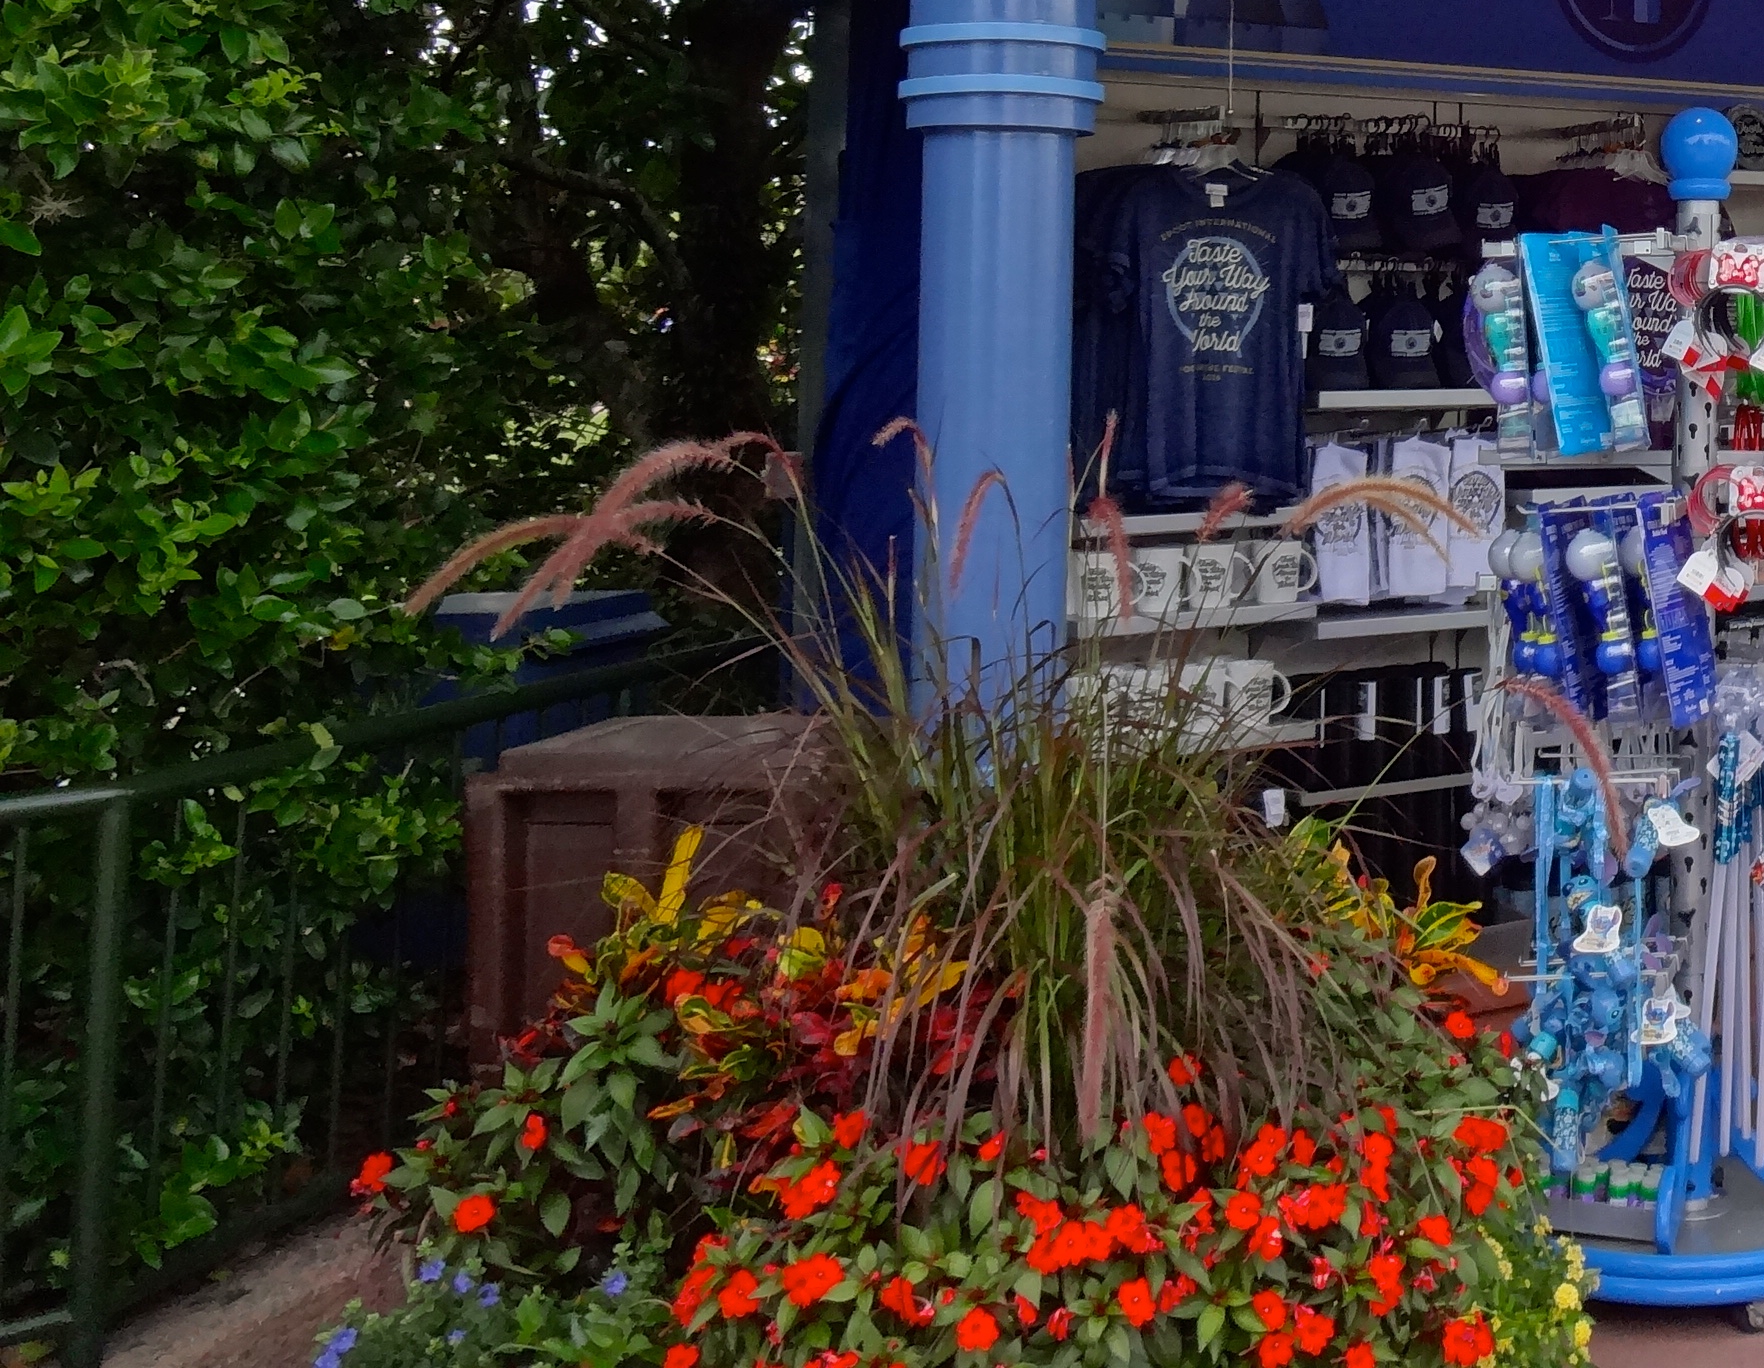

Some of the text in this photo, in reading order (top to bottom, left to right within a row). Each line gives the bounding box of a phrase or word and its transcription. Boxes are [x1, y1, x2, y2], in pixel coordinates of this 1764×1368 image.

[1195, 218, 1277, 244] INTERNATIONAL
[1187, 238, 1243, 264] Taste
[1161, 263, 1271, 299] Your Way
[1178, 288, 1249, 313] Around
[1647, 289, 1678, 313] Wa
[1198, 313, 1222, 327] the
[1632, 314, 1674, 334] ound
[1633, 332, 1651, 346] he
